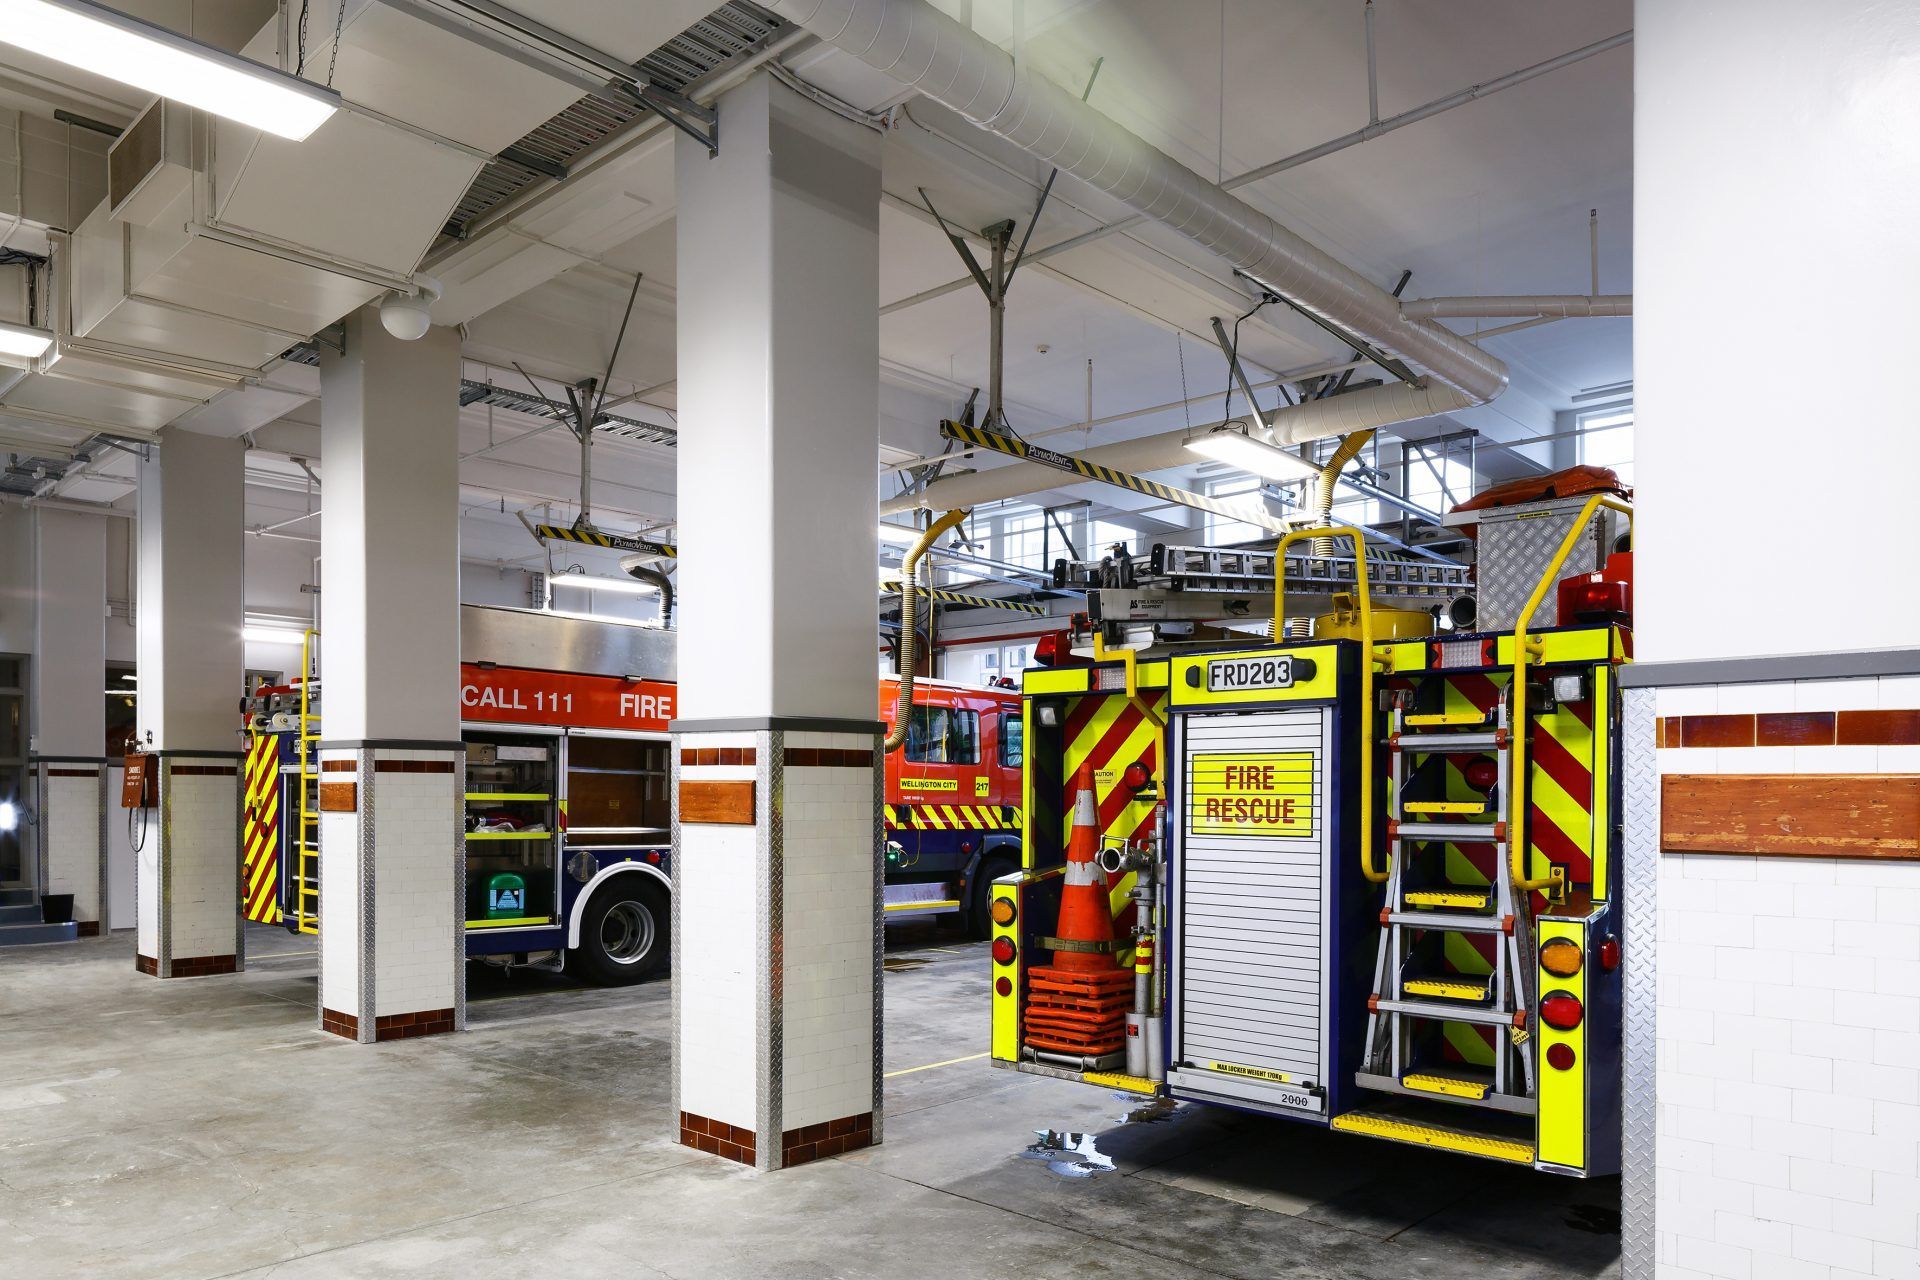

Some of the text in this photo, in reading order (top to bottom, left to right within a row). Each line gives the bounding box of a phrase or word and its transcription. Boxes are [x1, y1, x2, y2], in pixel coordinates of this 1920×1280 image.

[1211, 661, 1290, 686] FRD203
[461, 684, 671, 720] CALL 111 FIRE
[901, 780, 942, 788] WELLINGTON
[976, 783, 989, 791] 217
[1225, 766, 1275, 790] FIRE
[1206, 798, 1295, 824] RESCUE
[1216, 1063, 1228, 1071] MAX
[1228, 1065, 1247, 1074] LOCKER
[1247, 1068, 1267, 1077] WEIGHT
[1281, 1093, 1308, 1107] 2000
